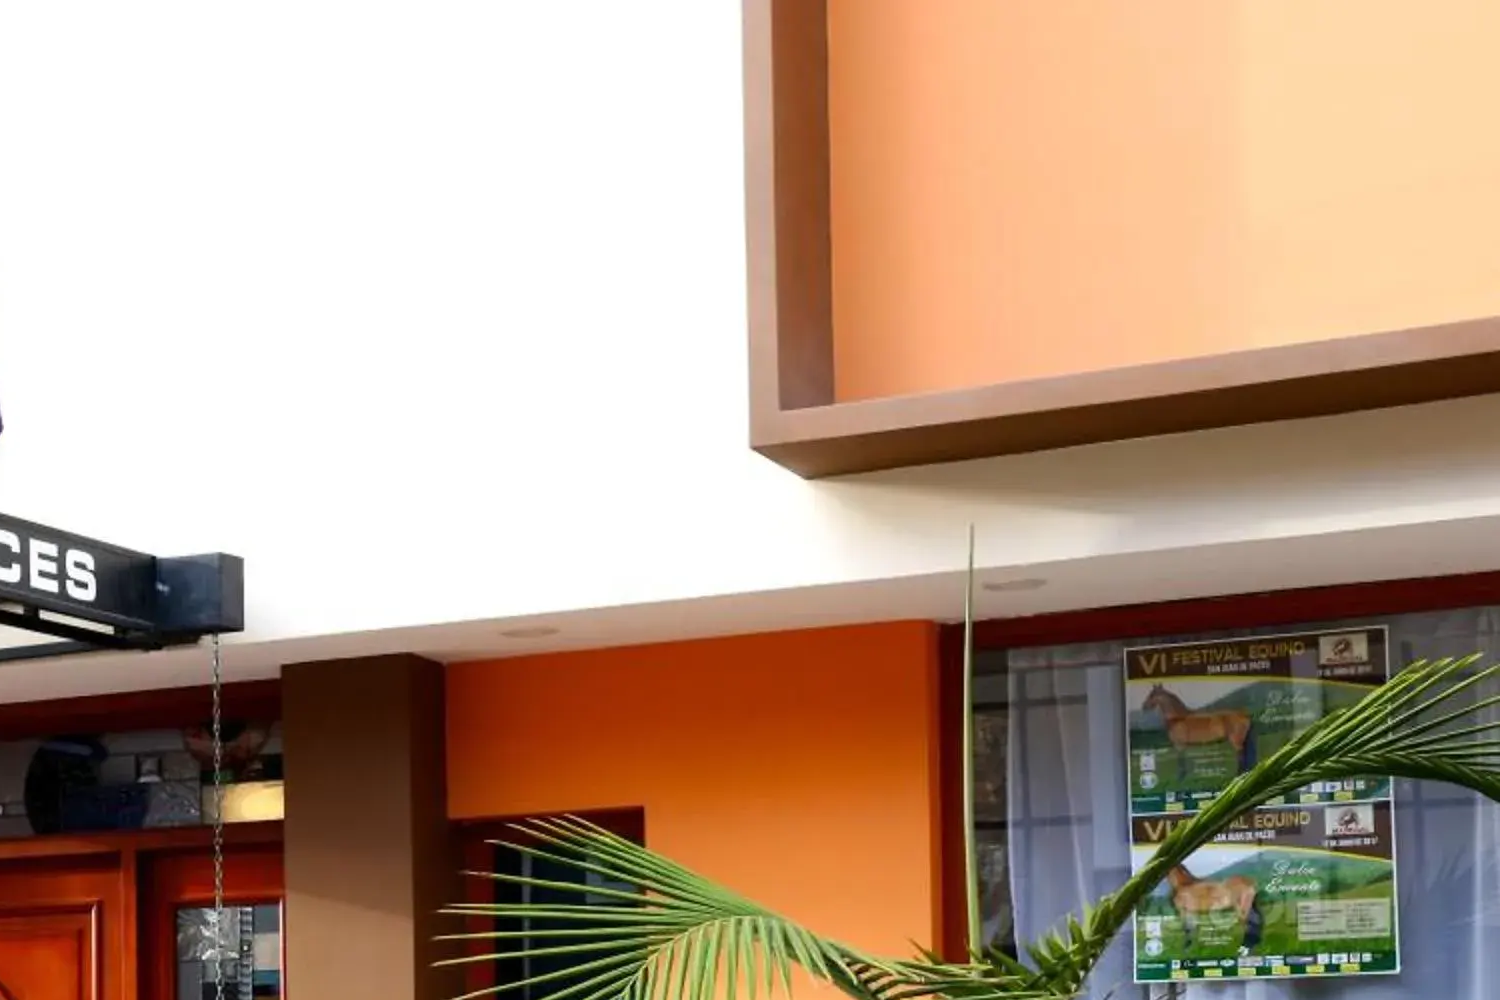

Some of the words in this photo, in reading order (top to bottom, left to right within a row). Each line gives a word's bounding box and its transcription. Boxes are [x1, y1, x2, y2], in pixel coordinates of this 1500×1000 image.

[1138, 653, 1167, 675] VI
[1172, 645, 1244, 666] FESTIVAL
[1249, 641, 1306, 660] EQUINO
[1255, 811, 1311, 829] EQUINO
